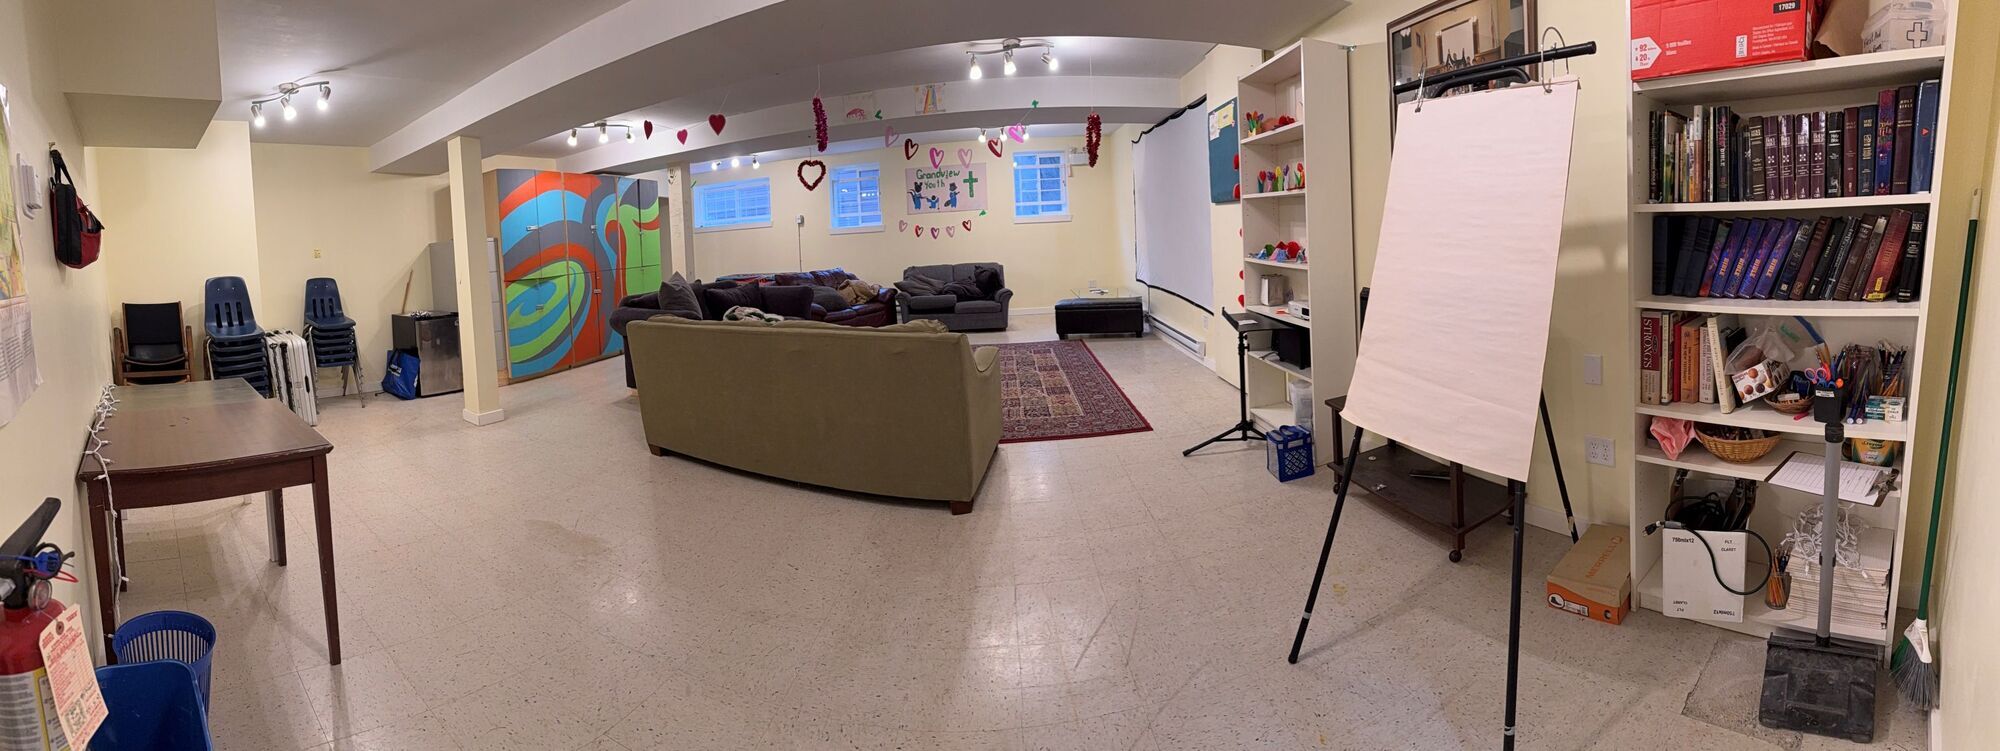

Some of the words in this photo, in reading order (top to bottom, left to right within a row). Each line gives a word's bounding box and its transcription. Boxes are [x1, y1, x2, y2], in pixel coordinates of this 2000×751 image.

[1779, 2, 1796, 11] 17029
[916, 167, 960, 179] Grandview
[924, 180, 945, 190] Youth
